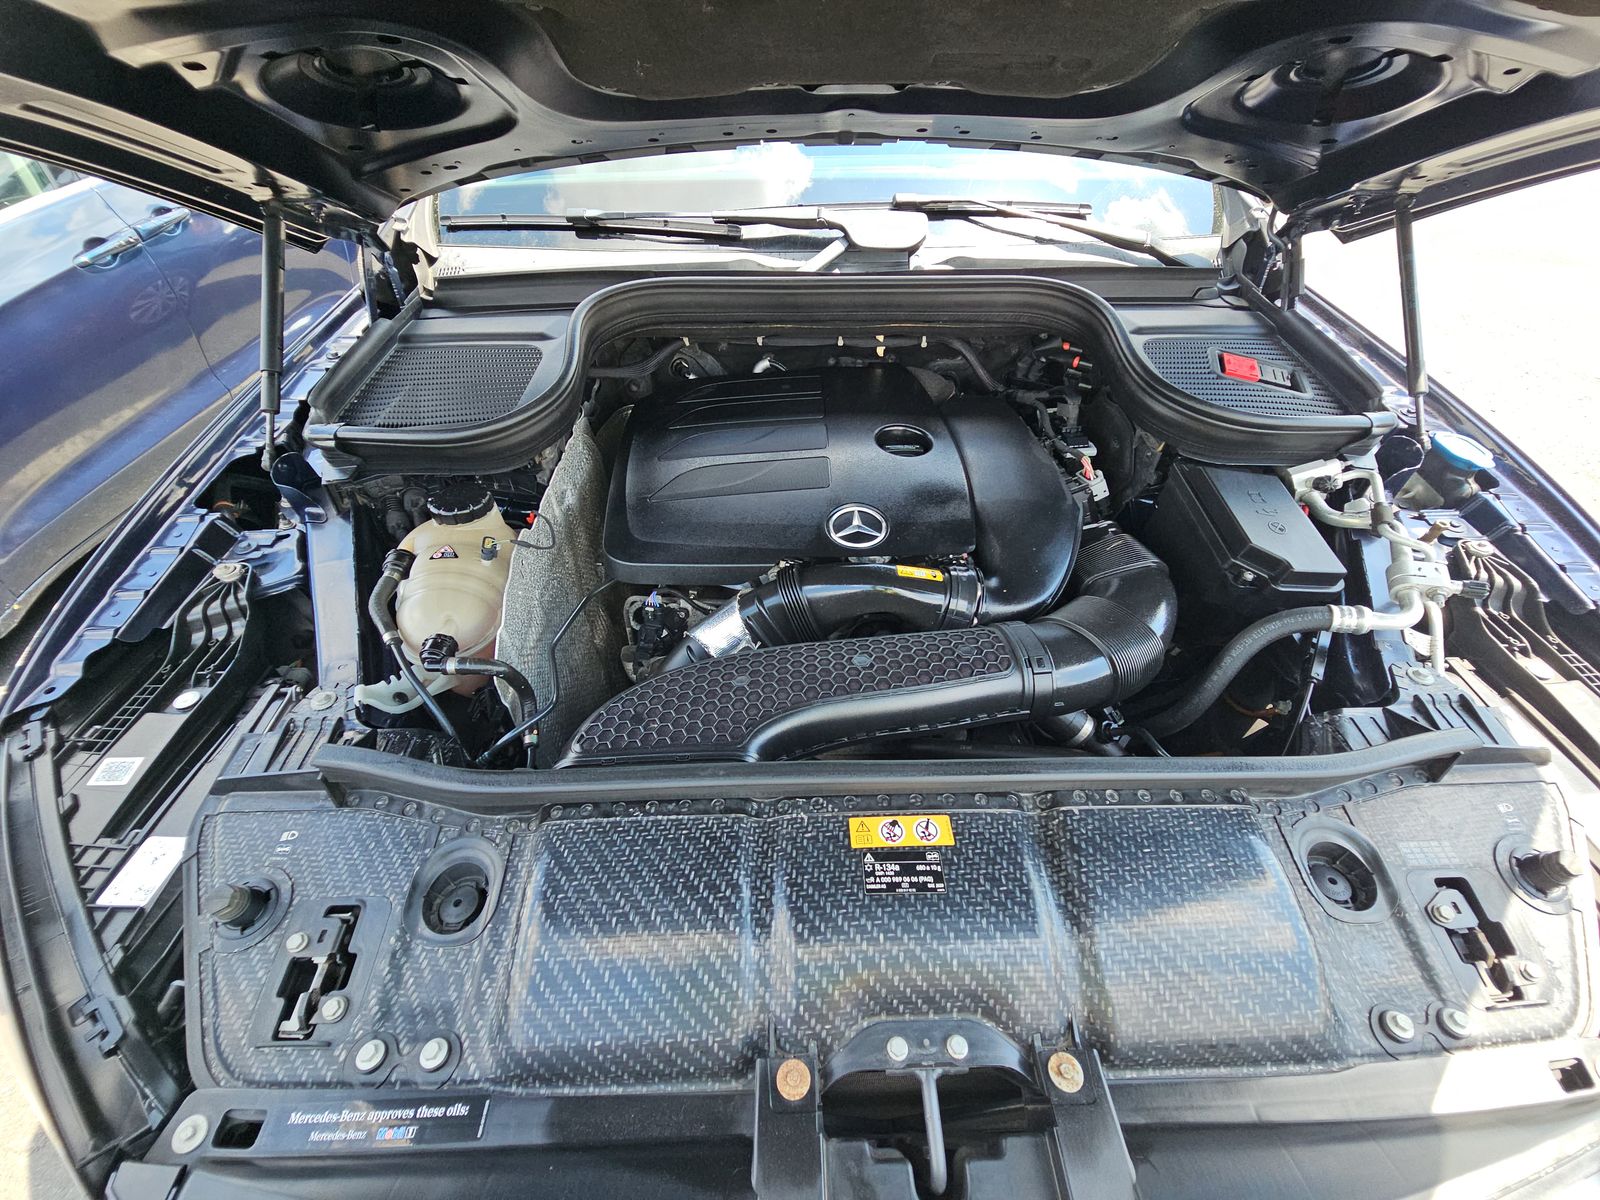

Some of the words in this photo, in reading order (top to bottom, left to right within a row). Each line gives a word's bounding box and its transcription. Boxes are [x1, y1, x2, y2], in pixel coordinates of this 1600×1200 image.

[874, 863, 900, 871] R-134a
[287, 1110, 366, 1125] Mercedes-Benz
[366, 1106, 415, 1123] approves
[416, 1104, 445, 1118] these
[446, 1102, 469, 1117] oils:
[308, 1129, 368, 1142] Mercedes-Benz
